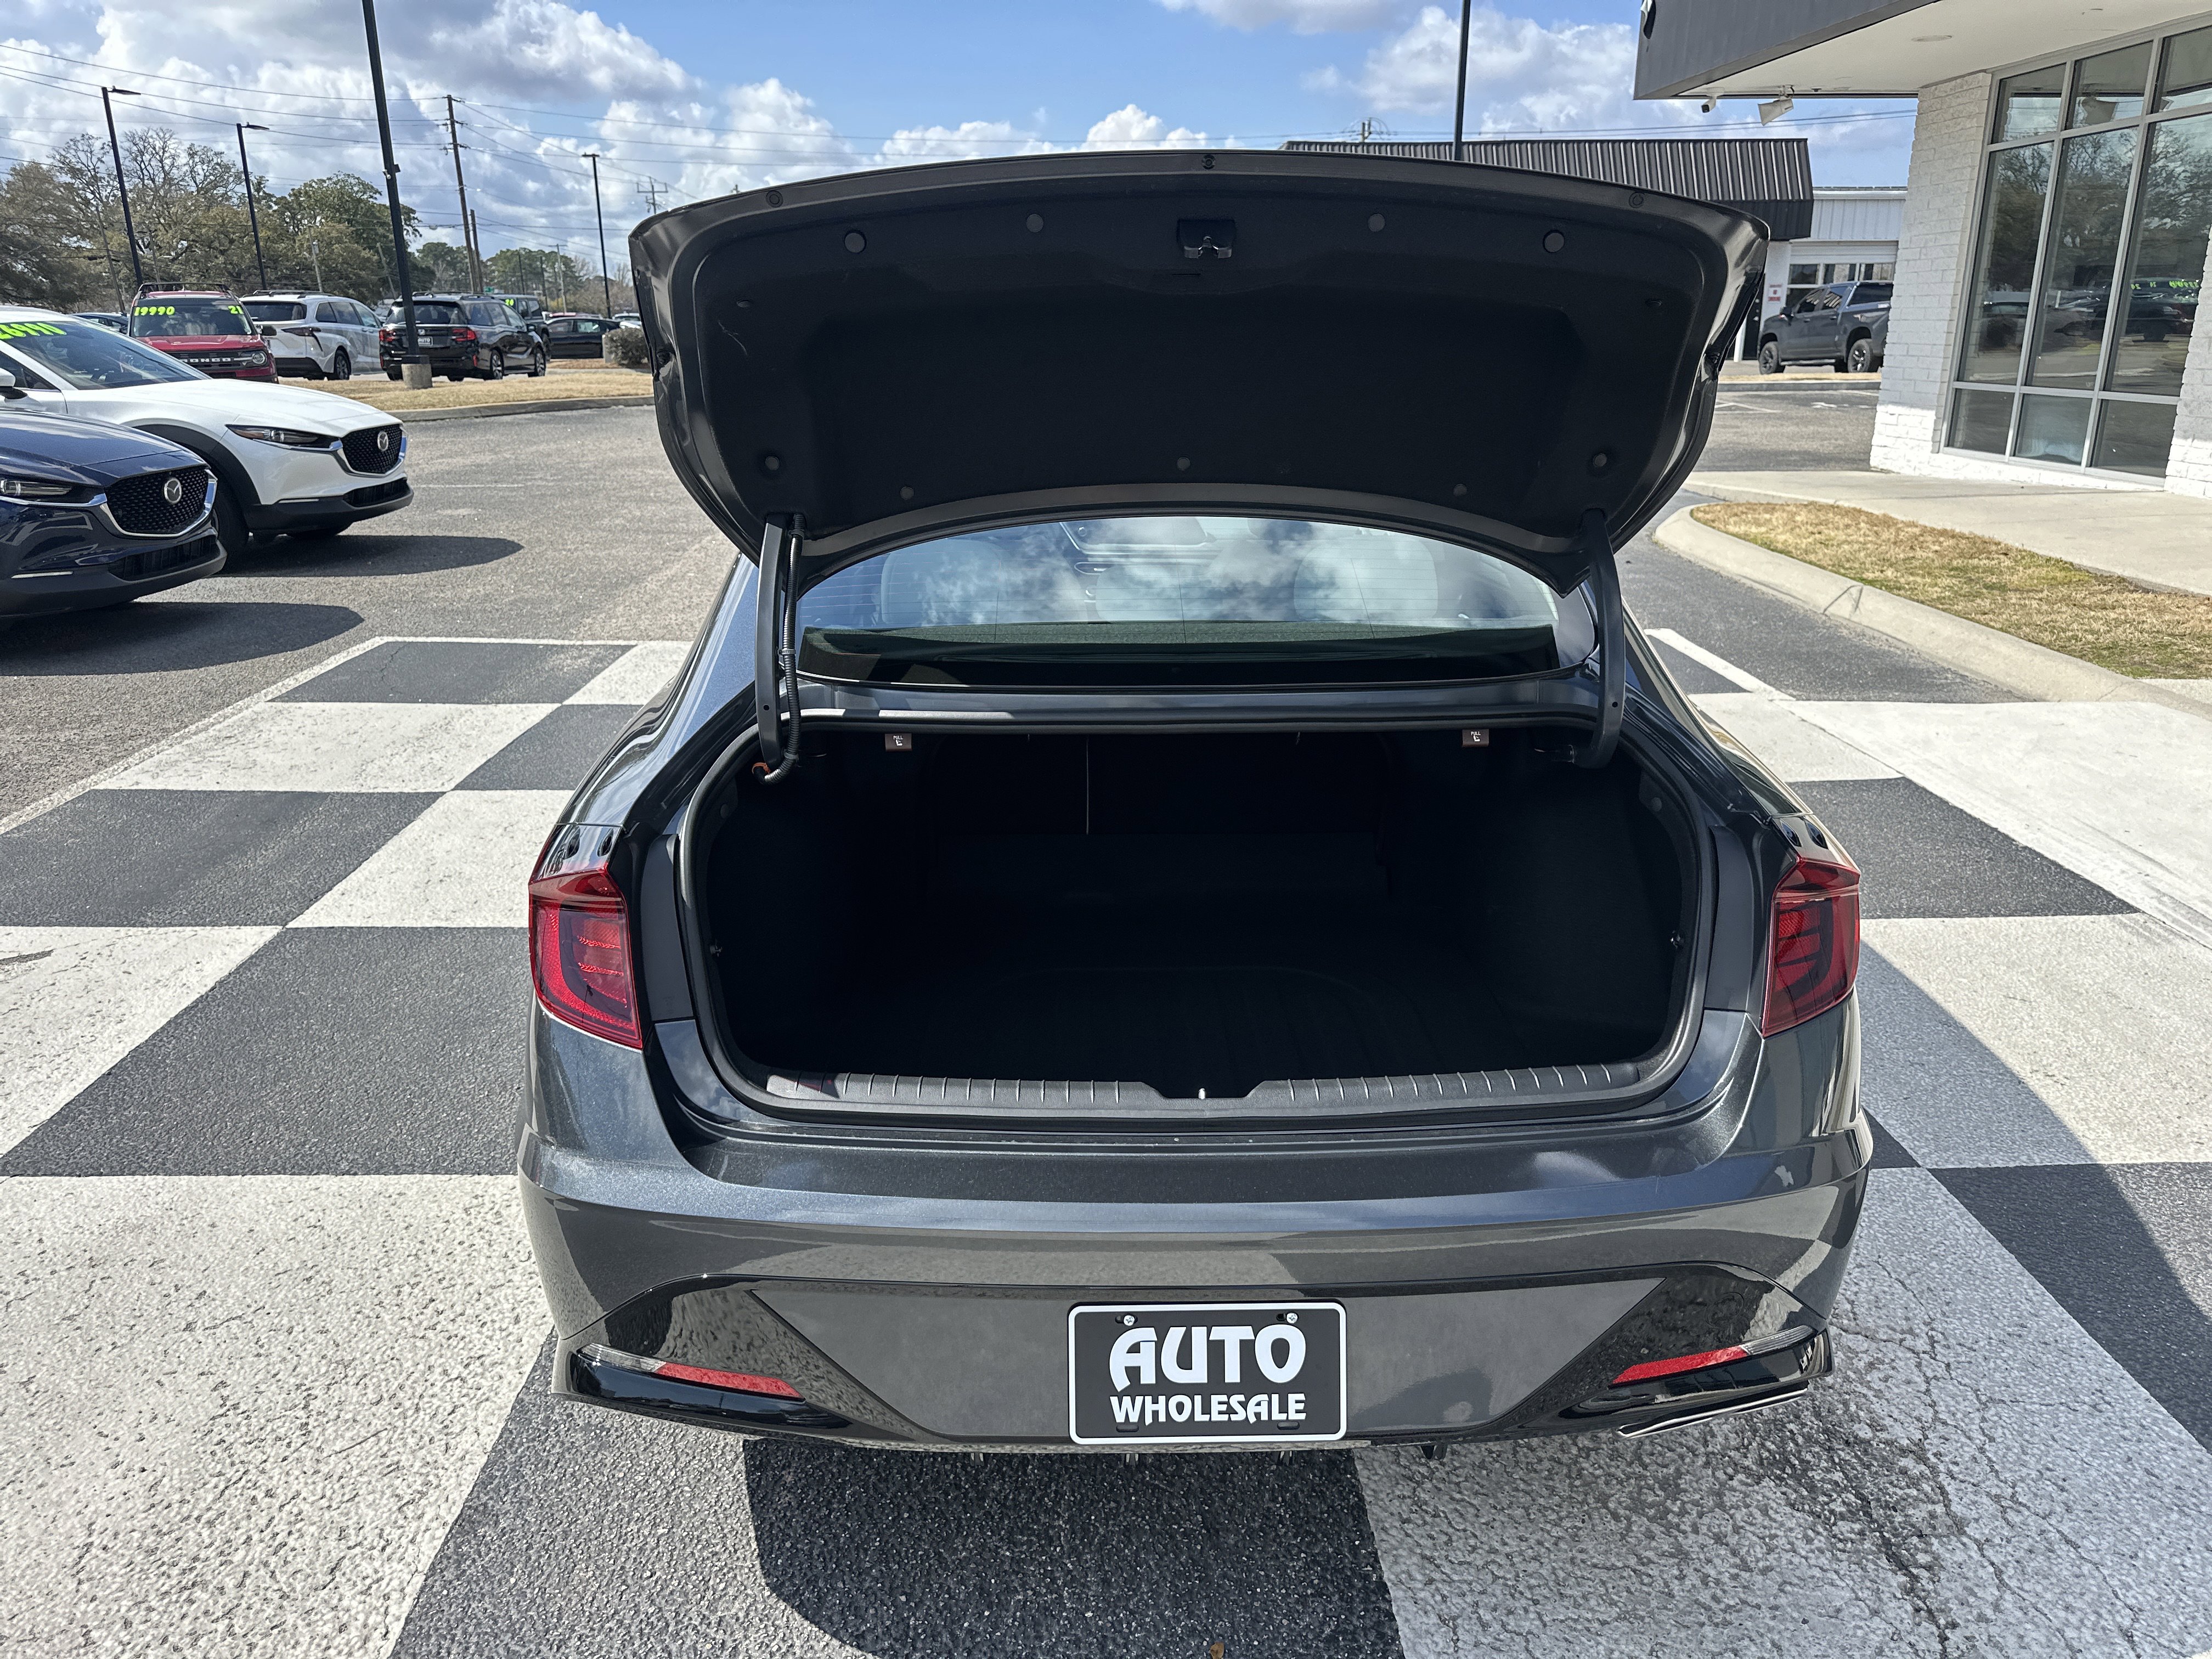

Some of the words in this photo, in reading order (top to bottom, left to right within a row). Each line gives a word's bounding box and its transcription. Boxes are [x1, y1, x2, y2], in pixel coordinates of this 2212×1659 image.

[134, 306, 175, 316] 19990
[228, 305, 244, 314] 21
[1109, 1324, 1306, 1392] AUTO
[1109, 1393, 1306, 1426] WHOLESALE
